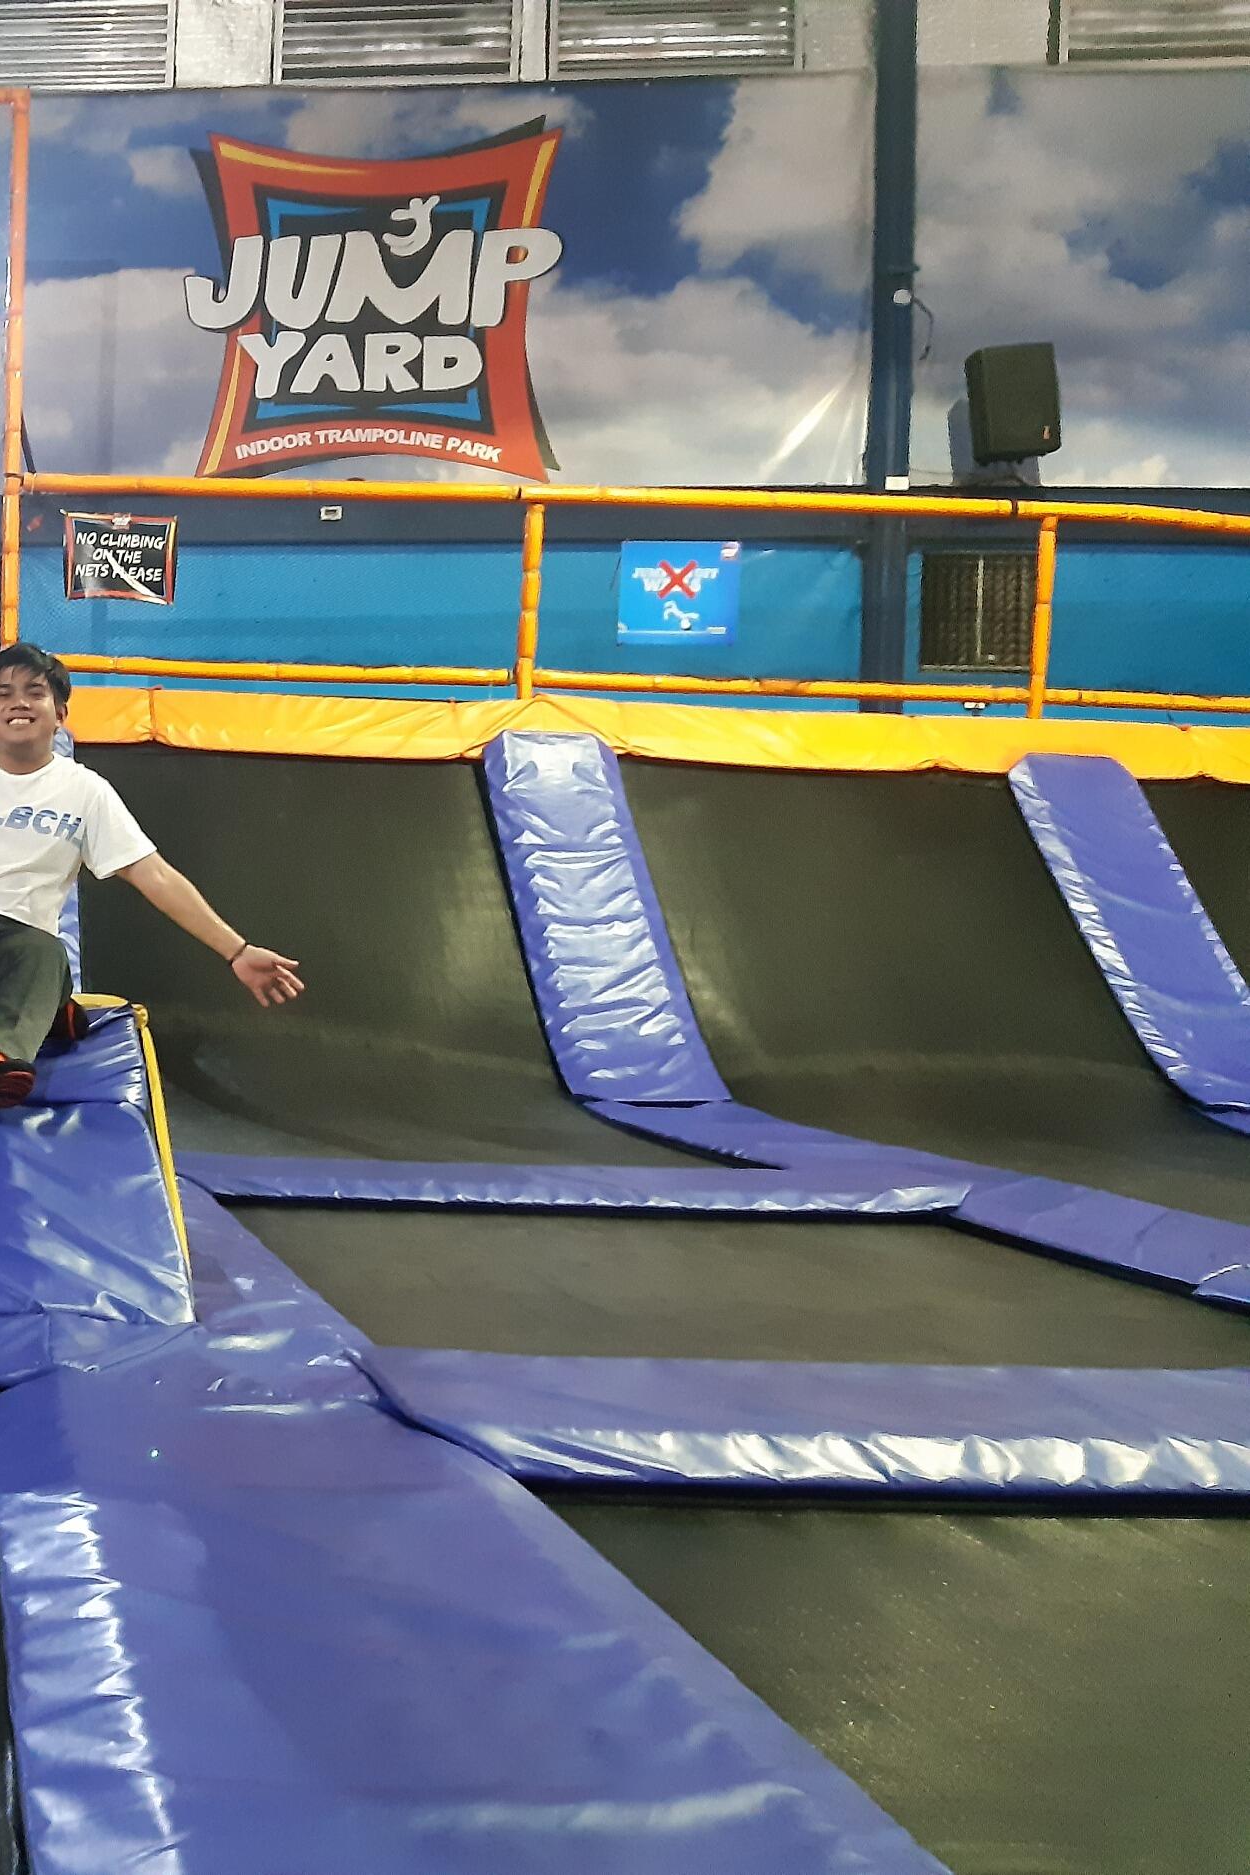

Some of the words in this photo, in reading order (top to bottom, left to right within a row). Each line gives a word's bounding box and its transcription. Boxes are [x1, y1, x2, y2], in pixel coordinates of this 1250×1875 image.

[183, 226, 563, 331] JUMP
[238, 331, 482, 399] YARD
[235, 431, 312, 460] INDOOR
[315, 428, 443, 450] TRAMPOLINE
[446, 437, 502, 463] PARK
[76, 532, 97, 545] NO
[100, 533, 166, 550] CLIMBING
[92, 548, 113, 561] ON
[116, 549, 142, 564] THE
[75, 564, 110, 577] NETS
